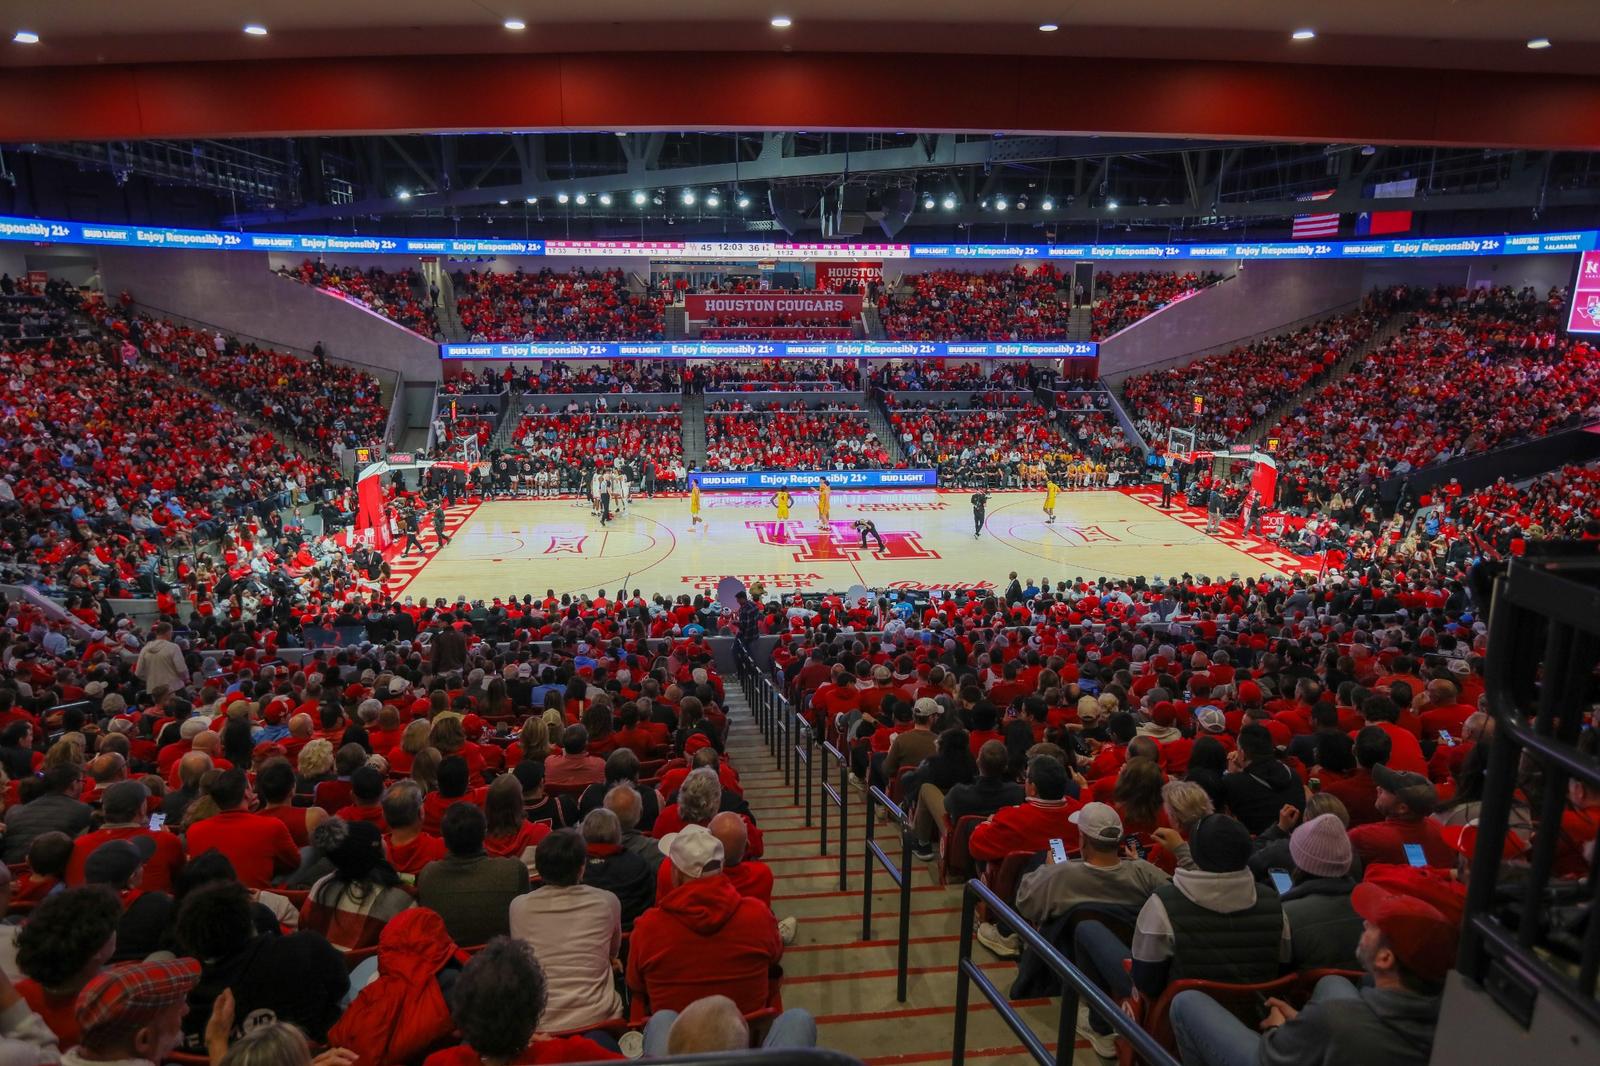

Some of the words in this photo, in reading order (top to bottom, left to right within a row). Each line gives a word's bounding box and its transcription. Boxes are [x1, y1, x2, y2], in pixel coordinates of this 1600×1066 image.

[52, 225, 69, 236] 21+
[84, 229, 101, 238] BUD
[102, 231, 126, 239] LIGHT
[137, 231, 164, 243] Enjoy
[166, 233, 223, 246] Responsibly
[225, 235, 240, 244] 21+
[271, 239, 292, 247] LIGHT
[302, 239, 326, 250] Enjoy
[329, 240, 380, 251] Responsibly
[382, 241, 396, 249] 21+
[454, 243, 476, 253] Enjoy
[478, 243, 526, 253] Responsibly
[748, 244, 759, 252] 36
[1394, 244, 1419, 254] Enjoy
[1421, 240, 1480, 253] Responsibly
[1482, 240, 1499, 250] 21+
[956, 248, 976, 257] Enjoy
[978, 248, 1022, 257] Responsibly
[1092, 248, 1113, 257] Enjoy
[1115, 248, 1163, 257] Responsibly
[1236, 247, 1260, 257] Enjoy
[1262, 246, 1314, 256] Responsibly
[1315, 245, 1331, 254] 21+
[828, 268, 883, 277] HOUSTON
[705, 300, 775, 311] HOUSTON
[777, 300, 843, 311] COUGARS
[450, 348, 466, 356] BUD
[468, 348, 491, 356] LIGHT
[502, 346, 528, 358] Enjoy
[531, 346, 588, 358] Responsibly
[590, 346, 607, 356] 21+
[622, 347, 637, 355] BUD
[638, 347, 660, 355] LIGHT
[672, 346, 698, 357] Enjoy
[700, 346, 756, 358] Responsibly
[758, 346, 774, 356] 21+
[788, 347, 803, 355] BUD
[804, 347, 826, 355] LIGHT
[837, 345, 862, 357] Enjoy
[864, 345, 918, 356] Responsibly
[920, 345, 935, 354] 21+
[996, 345, 1020, 357] Enjoy
[1022, 345, 1074, 356] Responsibly
[1076, 345, 1090, 354] 21+
[702, 477, 719, 485] BUD
[721, 477, 746, 485] LIGHT
[760, 474, 788, 486] Enjoy
[790, 473, 848, 485] Resposibly
[850, 474, 866, 483] 21+
[881, 474, 900, 483] BUD
[902, 474, 924, 482] LIGHT
